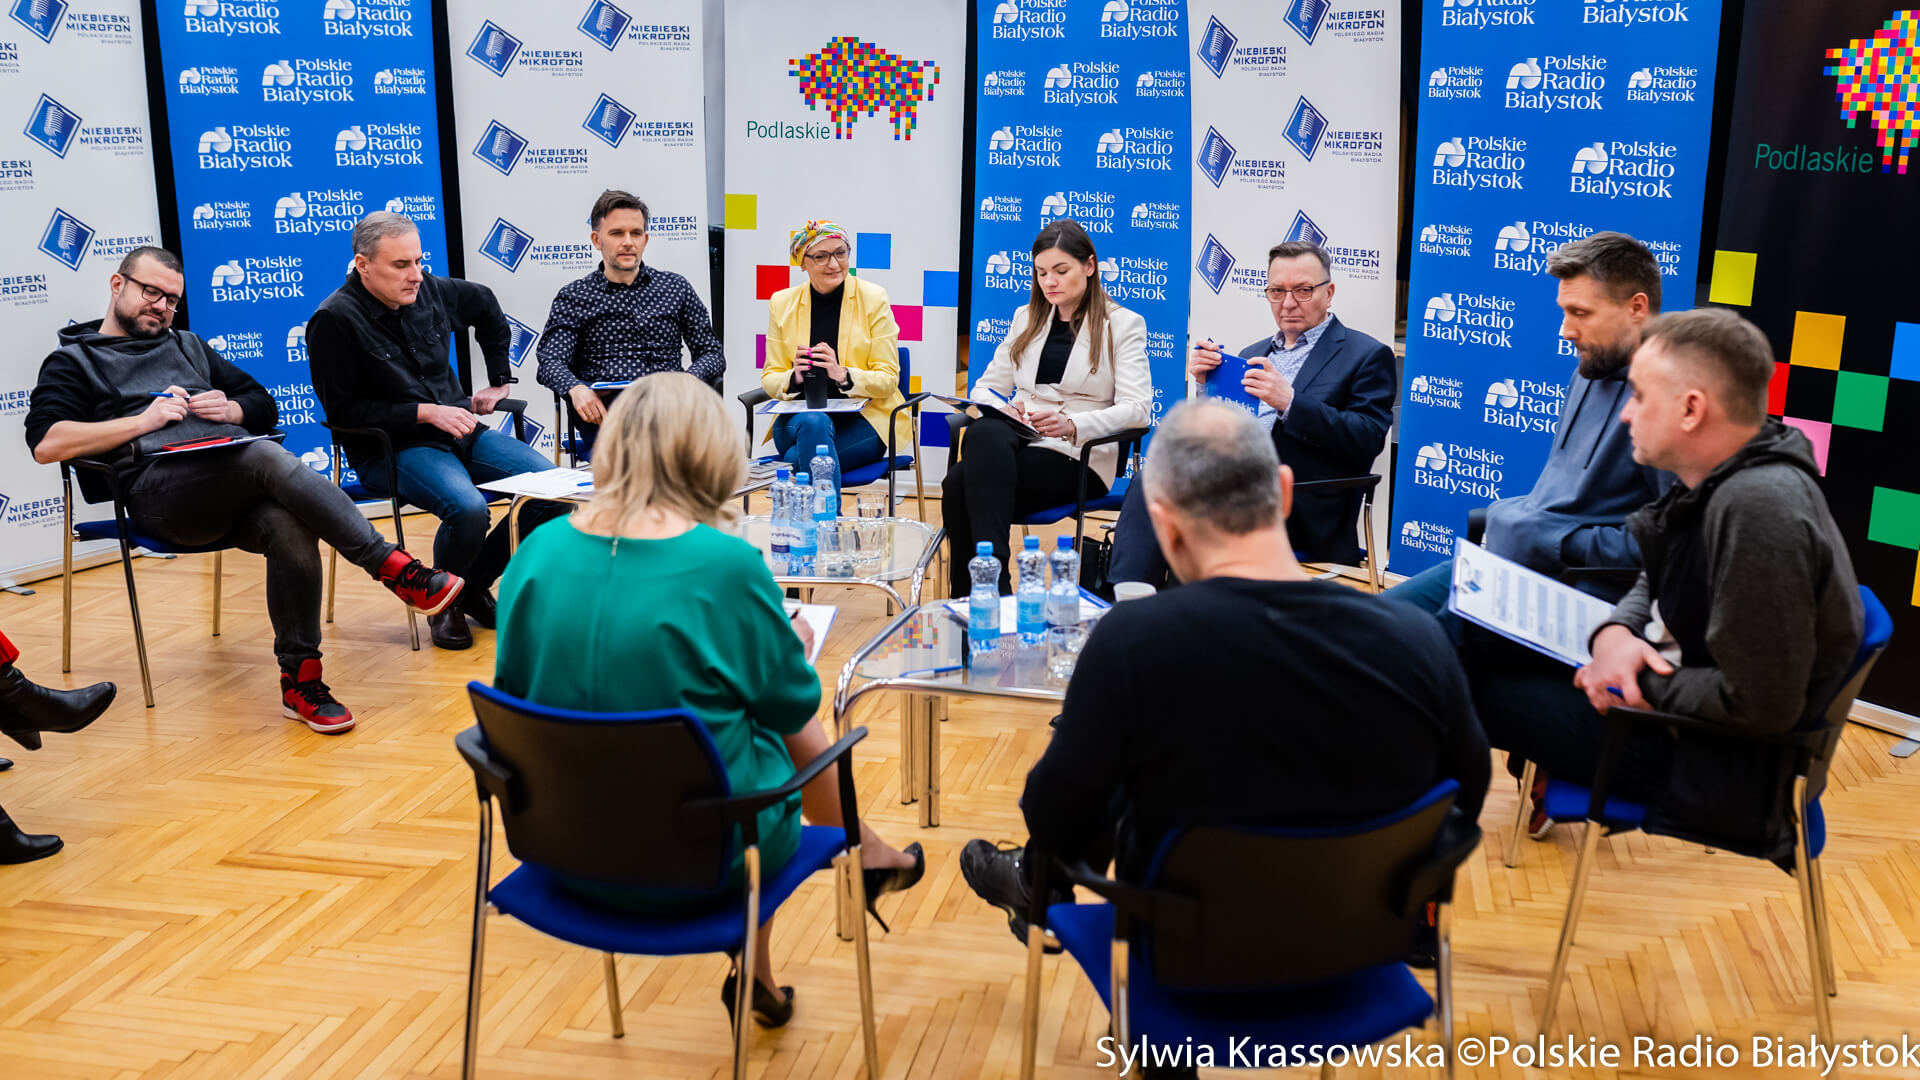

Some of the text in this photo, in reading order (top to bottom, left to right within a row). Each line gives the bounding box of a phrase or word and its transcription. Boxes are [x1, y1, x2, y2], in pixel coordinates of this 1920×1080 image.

[221, 3, 279, 18] Radio
[357, 6, 412, 22] Radio
[1019, 9, 1067, 24] Radio
[1129, 7, 1179, 22] Radio
[1329, 10, 1385, 21] NIEBIESKI
[1583, 2, 1689, 27] Białystok
[68, 13, 130, 23] NIEBIESKI
[1442, 7, 1536, 30] Białystok
[66, 22, 131, 32] MIKROFON
[185, 17, 281, 37] Białystok
[324, 20, 413, 39] Białystok
[631, 25, 690, 33] NIEBIESKI
[1100, 23, 1179, 41] Białystok
[1326, 20, 1385, 31] MIKROFON
[628, 32, 690, 41] MIKROFON
[992, 25, 1066, 42] Białystok
[521, 50, 583, 59] NIEBIESKI
[1236, 46, 1287, 56] NIEBIESKI
[295, 58, 353, 72] Polskie
[519, 58, 583, 67] MIKROFON
[1073, 61, 1120, 74] Polskie
[1233, 56, 1287, 65] MIKROFON
[1544, 54, 1607, 71] Polskie
[201, 66, 237, 75] Polskie
[393, 67, 426, 77] Polskie
[998, 70, 1026, 79] Polskie
[1154, 70, 1186, 79] Polskie
[1448, 66, 1484, 76] Polskie
[1653, 66, 1698, 77] Polskie
[200, 74, 238, 85] Radio
[296, 72, 353, 87] Radio
[393, 76, 426, 86] Radio
[998, 78, 1026, 87] Radio
[1072, 74, 1119, 89] Radio
[1154, 78, 1186, 88] Radio
[1447, 75, 1483, 87] Radio
[1542, 71, 1606, 91] Radio
[1652, 76, 1697, 90] Radio
[179, 83, 240, 96] Białystok
[263, 87, 355, 105] Białystok
[374, 85, 427, 96] Białystok
[984, 86, 1025, 98] Białystok
[1136, 87, 1185, 99] Białystok
[1428, 87, 1482, 100] Białystok
[1627, 89, 1695, 104] Białystok
[1044, 89, 1118, 107] Białystok
[1504, 90, 1603, 113] Białystok
[82, 127, 142, 136] NIEBIESKI
[232, 124, 291, 137] Polskie
[367, 123, 421, 136] Polskie
[635, 121, 694, 129] NIEBIESKI
[747, 120, 831, 140] Podlaskie
[1015, 125, 1063, 137] Polskie
[632, 128, 694, 137] MIKROFON
[1125, 127, 1174, 140] Polskie
[1327, 131, 1383, 140] NIEBIESKI
[79, 135, 143, 145] MIKROFON
[233, 137, 292, 153] Radio
[367, 136, 422, 151] Radio
[1014, 138, 1062, 152] Radio
[1324, 140, 1382, 150] MIKROFON
[1467, 136, 1527, 152] Polskie
[527, 148, 588, 157] NIEBIESKI
[1124, 140, 1173, 155] Radio
[1611, 141, 1677, 158] Polskie
[199, 153, 293, 172] Białystok
[336, 150, 423, 169] Białystok
[524, 156, 588, 165] MIKROFON
[988, 152, 1061, 169] Białystok
[1096, 155, 1172, 173] Białystok
[1234, 160, 1285, 169] NIEBIESKI
[1466, 152, 1526, 171] Radio
[1755, 143, 1874, 173] Podlaskie
[1232, 168, 1285, 178] MIKROFON
[1608, 158, 1675, 179] Radio
[1432, 169, 1524, 191] Białystok
[307, 188, 364, 202] Polskie
[1570, 176, 1673, 200] Białystok
[403, 195, 435, 204] Polskie
[994, 195, 1023, 204] Polskie
[1068, 190, 1116, 204] Polskie
[214, 200, 250, 210] Polskie
[307, 201, 364, 217] Radio
[403, 203, 436, 213] Radio
[994, 203, 1022, 213] Radio
[1068, 204, 1115, 219] Radio
[1148, 202, 1181, 211] Polskie
[213, 209, 251, 220] Radio
[649, 216, 697, 224] IEBIESKI
[980, 211, 1022, 223] Białystok
[1148, 210, 1180, 220] Radio
[193, 218, 252, 231] Białystok
[1131, 218, 1179, 231] Białystok
[1438, 224, 1473, 235] Polskie
[1532, 221, 1594, 238] Polskie
[95, 235, 154, 246] NIEBIESKI
[1437, 234, 1472, 246] Radio
[533, 244, 593, 253] NIEBIESKI
[1419, 242, 1471, 258] Białystok
[245, 256, 303, 270] Polskie
[530, 252, 593, 261] MIKROFON
[1121, 256, 1169, 271] Polskie
[246, 269, 304, 285] Radio
[1120, 270, 1168, 286] Radio
[1234, 268, 1267, 278] NIEBIE
[985, 275, 1032, 293] Białys
[212, 285, 305, 304] Białystok
[1103, 283, 1167, 301] iałystok
[1457, 293, 1516, 312] Polskie
[1456, 308, 1514, 330] Radio
[226, 331, 263, 341] Polskie
[1423, 322, 1513, 349] Białystok
[226, 340, 264, 350] Radio
[1429, 375, 1463, 389] Polskie
[266, 383, 314, 398] olskie
[1428, 385, 1463, 399] Radio
[275, 396, 315, 412] adio
[1410, 392, 1462, 410] Białystok
[1449, 443, 1505, 465] Polskie
[1447, 458, 1503, 483] Radio
[1414, 469, 1501, 501] Białystok
[8, 505, 64, 523] MIKROFO
[1421, 521, 1454, 536] Polskie
[1420, 530, 1454, 546] Radio
[1401, 535, 1453, 557] Białystok
